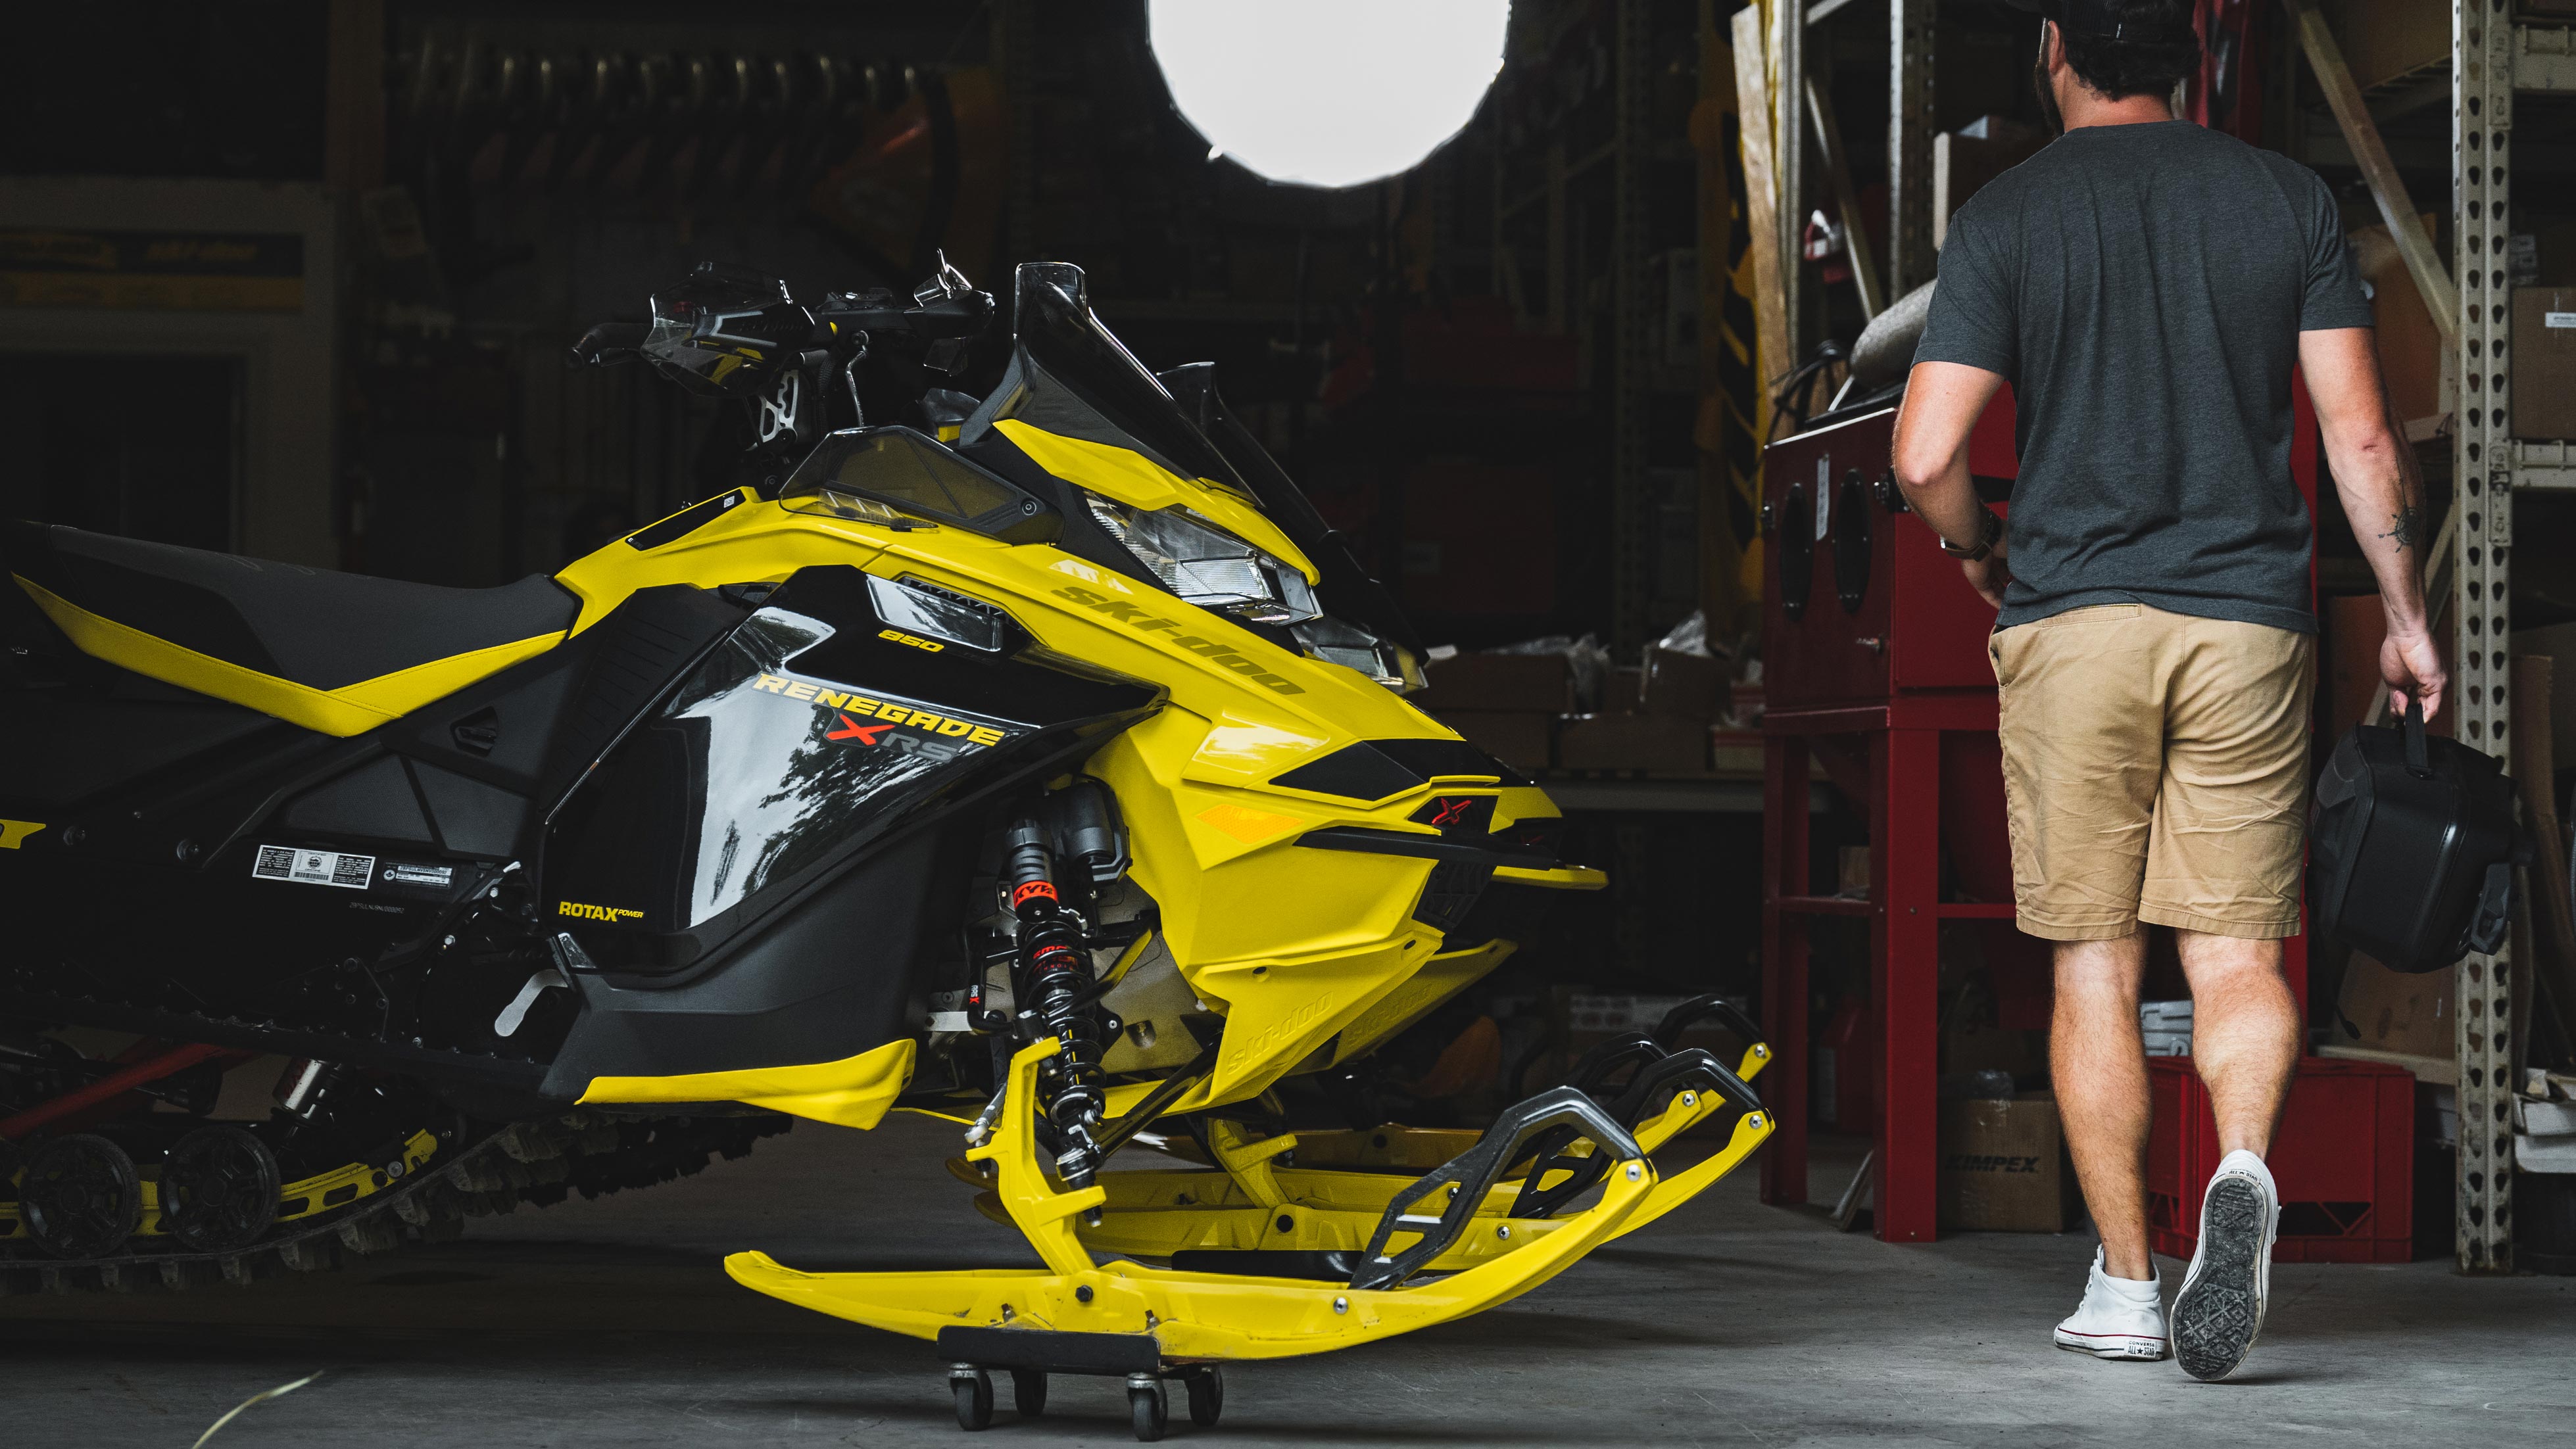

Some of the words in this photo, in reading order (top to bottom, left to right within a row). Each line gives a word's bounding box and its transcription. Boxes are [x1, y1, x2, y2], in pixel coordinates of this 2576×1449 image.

[877, 629, 945, 653] 850
[1051, 585, 1305, 696] ski-doo
[752, 673, 1006, 747] RENEGADE
[558, 901, 619, 922] ROTAX
[618, 909, 644, 918] POWER
[1227, 991, 1334, 1076] ski-doo
[1945, 1154, 2041, 1173] KIMPEX
[2127, 1345, 2137, 1355] ALL
[2143, 1347, 2155, 1357] STAR
